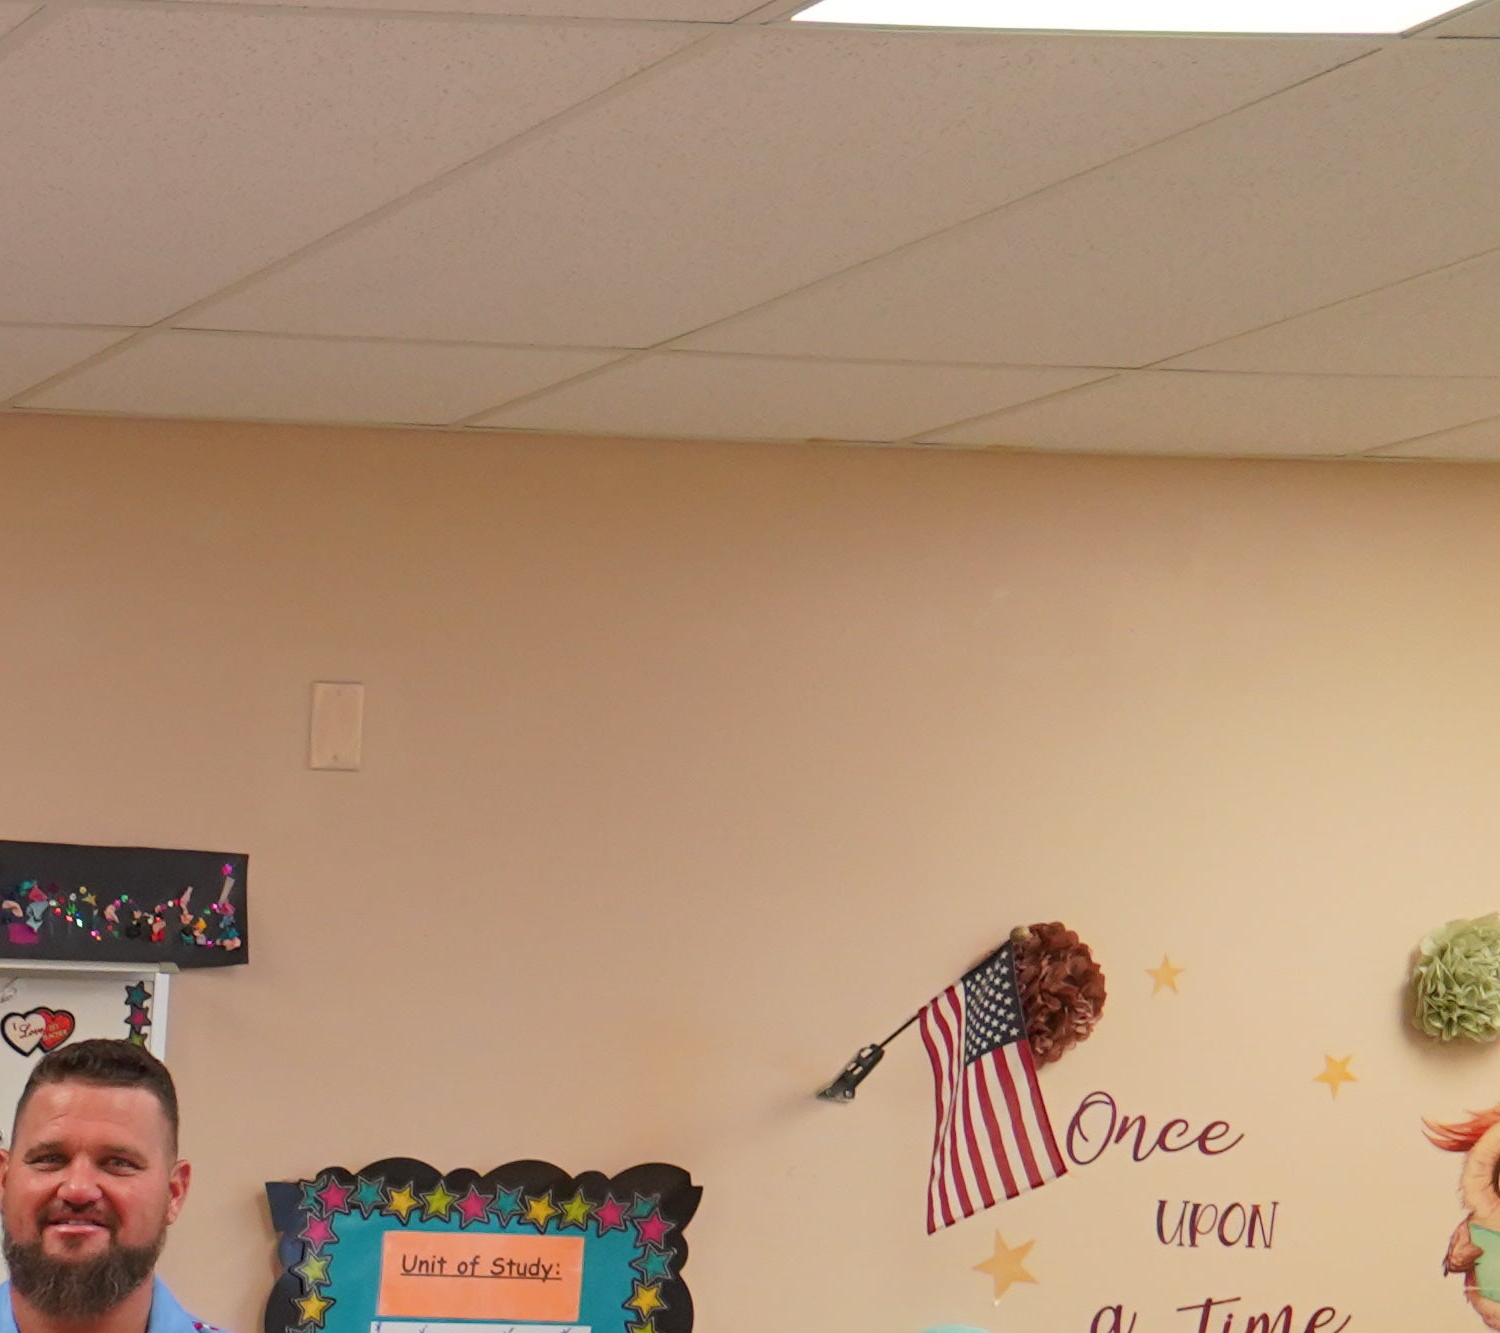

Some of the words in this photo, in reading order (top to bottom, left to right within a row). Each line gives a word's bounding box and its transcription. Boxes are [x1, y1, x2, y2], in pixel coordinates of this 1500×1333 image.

[1066, 1091, 1244, 1166] Once
[1156, 1201, 1279, 1249] UPON
[401, 1255, 448, 1276] Unit
[457, 1256, 480, 1276] of
[490, 1257, 562, 1283] Study:
